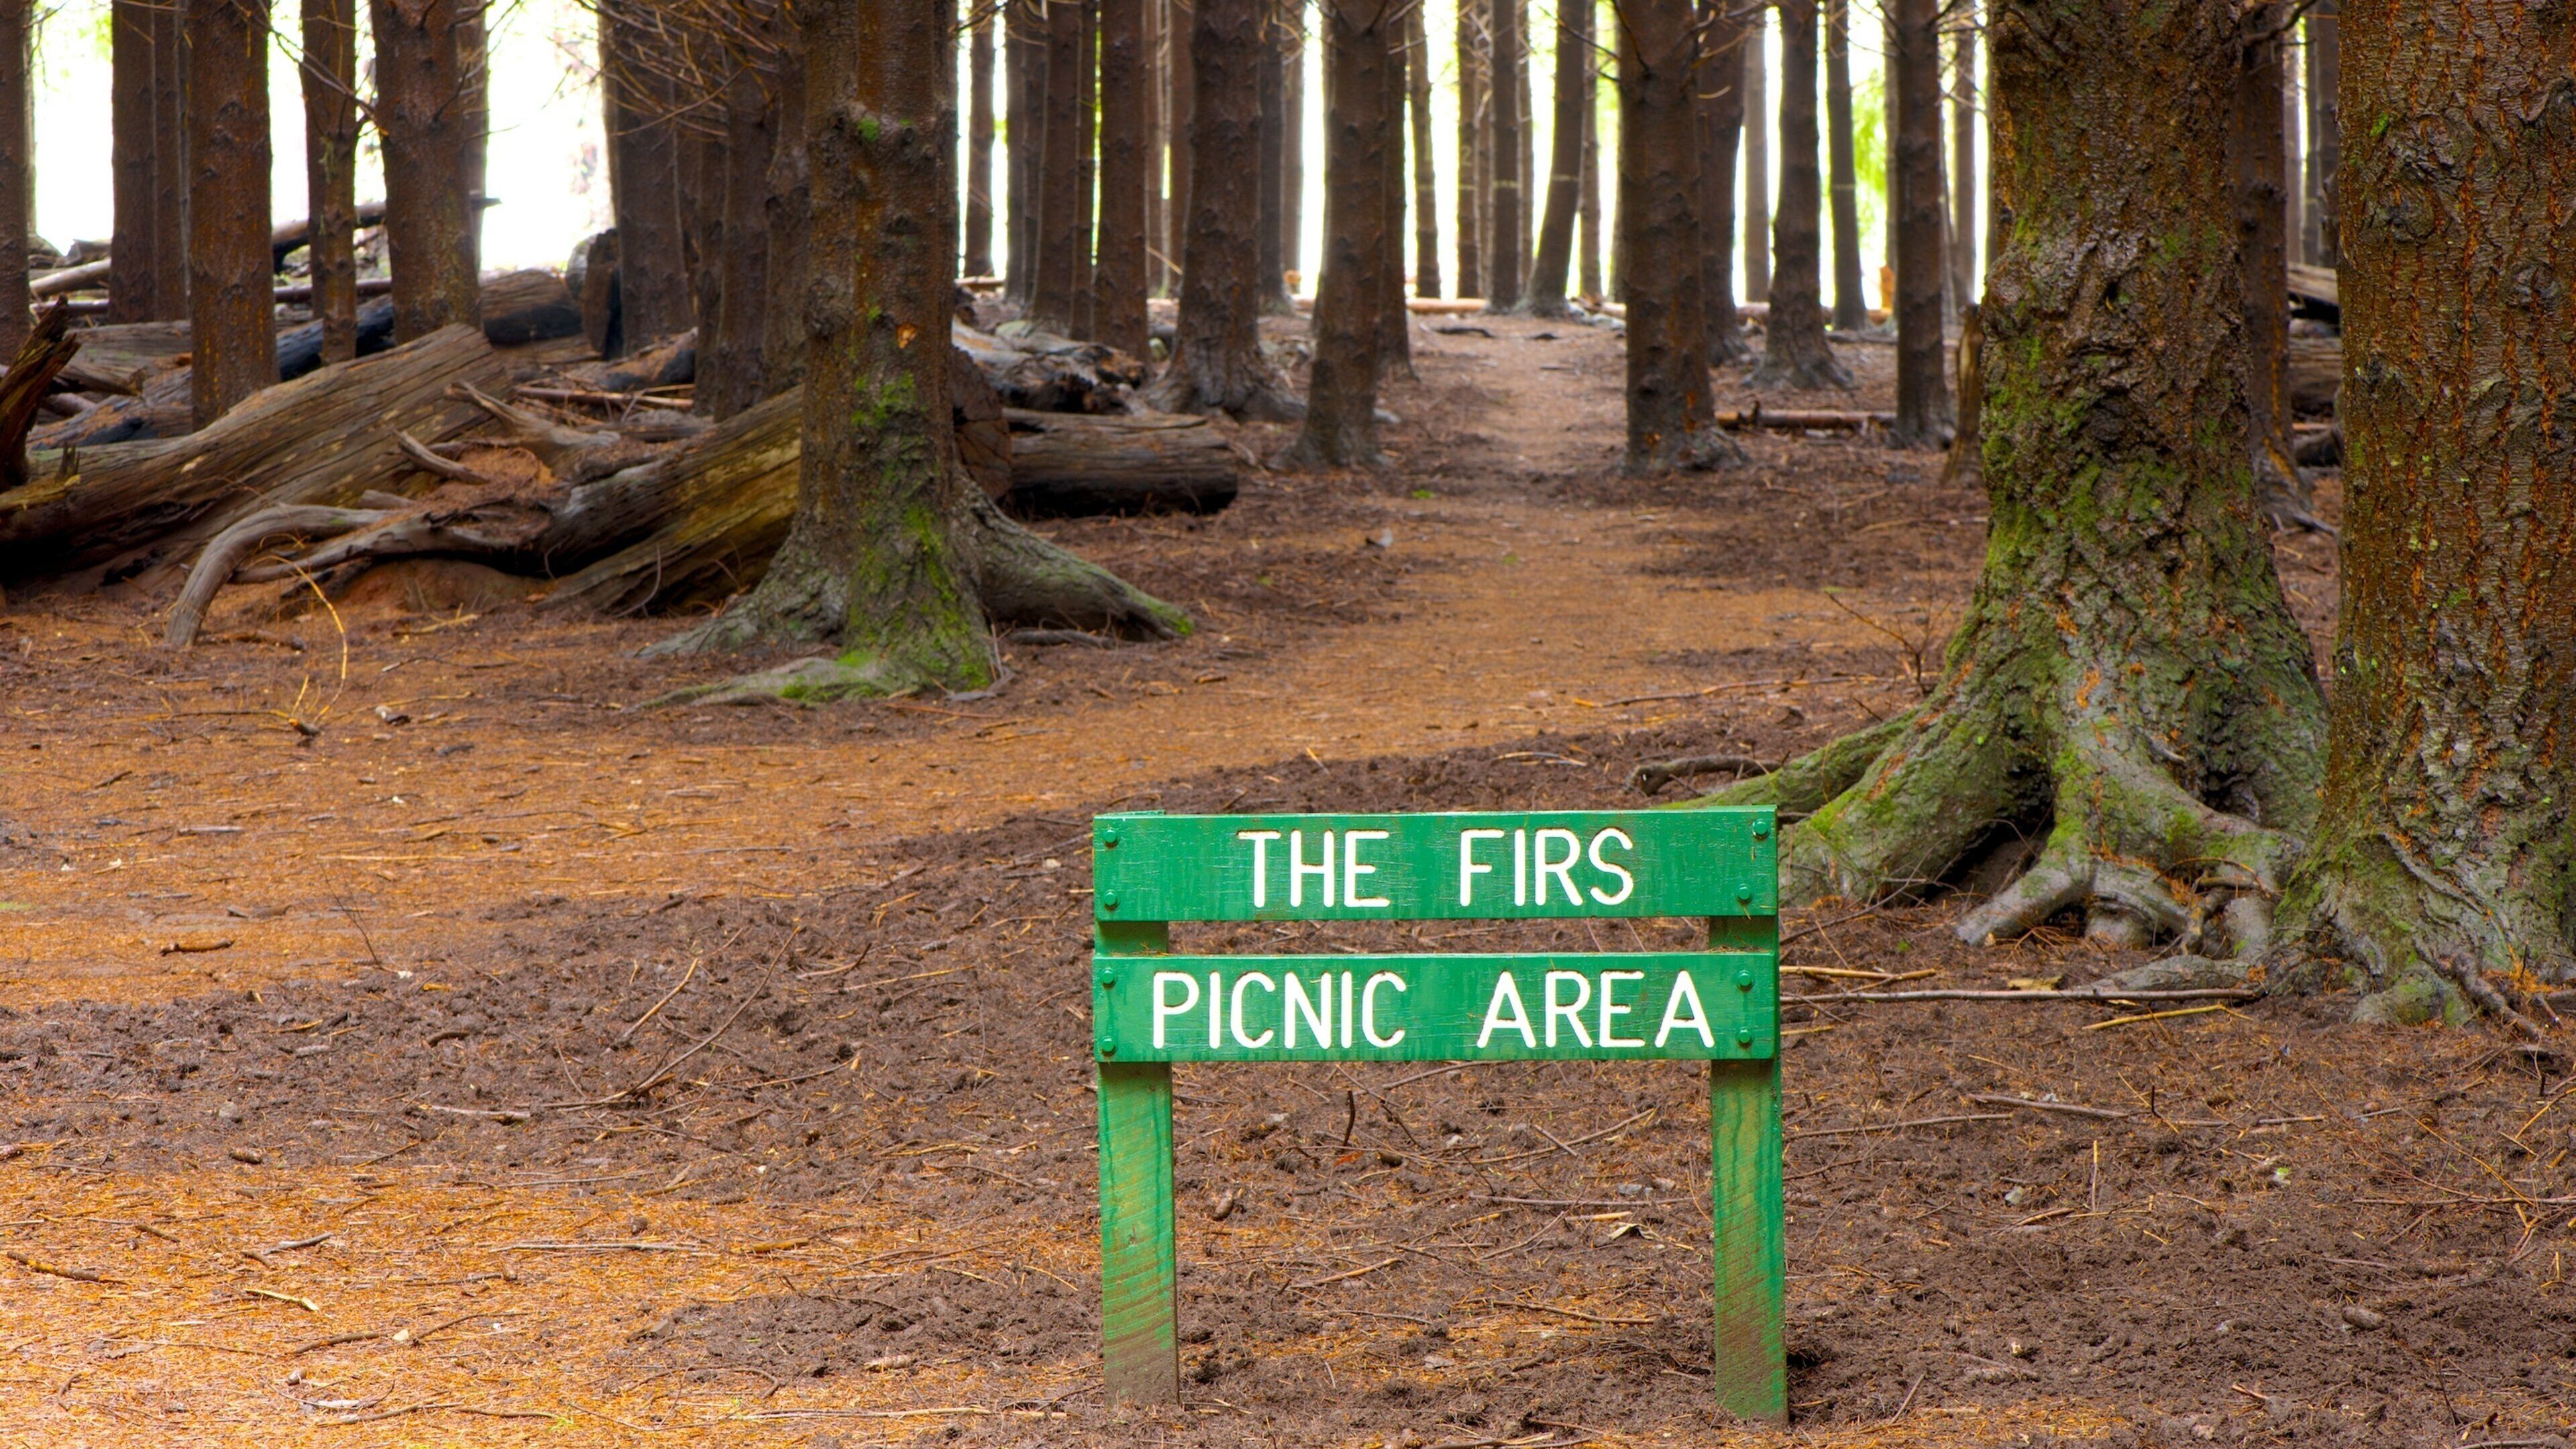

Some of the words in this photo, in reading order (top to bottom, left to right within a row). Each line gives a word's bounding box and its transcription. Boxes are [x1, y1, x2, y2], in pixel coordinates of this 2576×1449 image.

[1237, 829, 1391, 909] THE
[1459, 827, 1635, 908] FIRS
[1152, 971, 1407, 1050] PICNIC
[1475, 970, 1715, 1049] AREA
